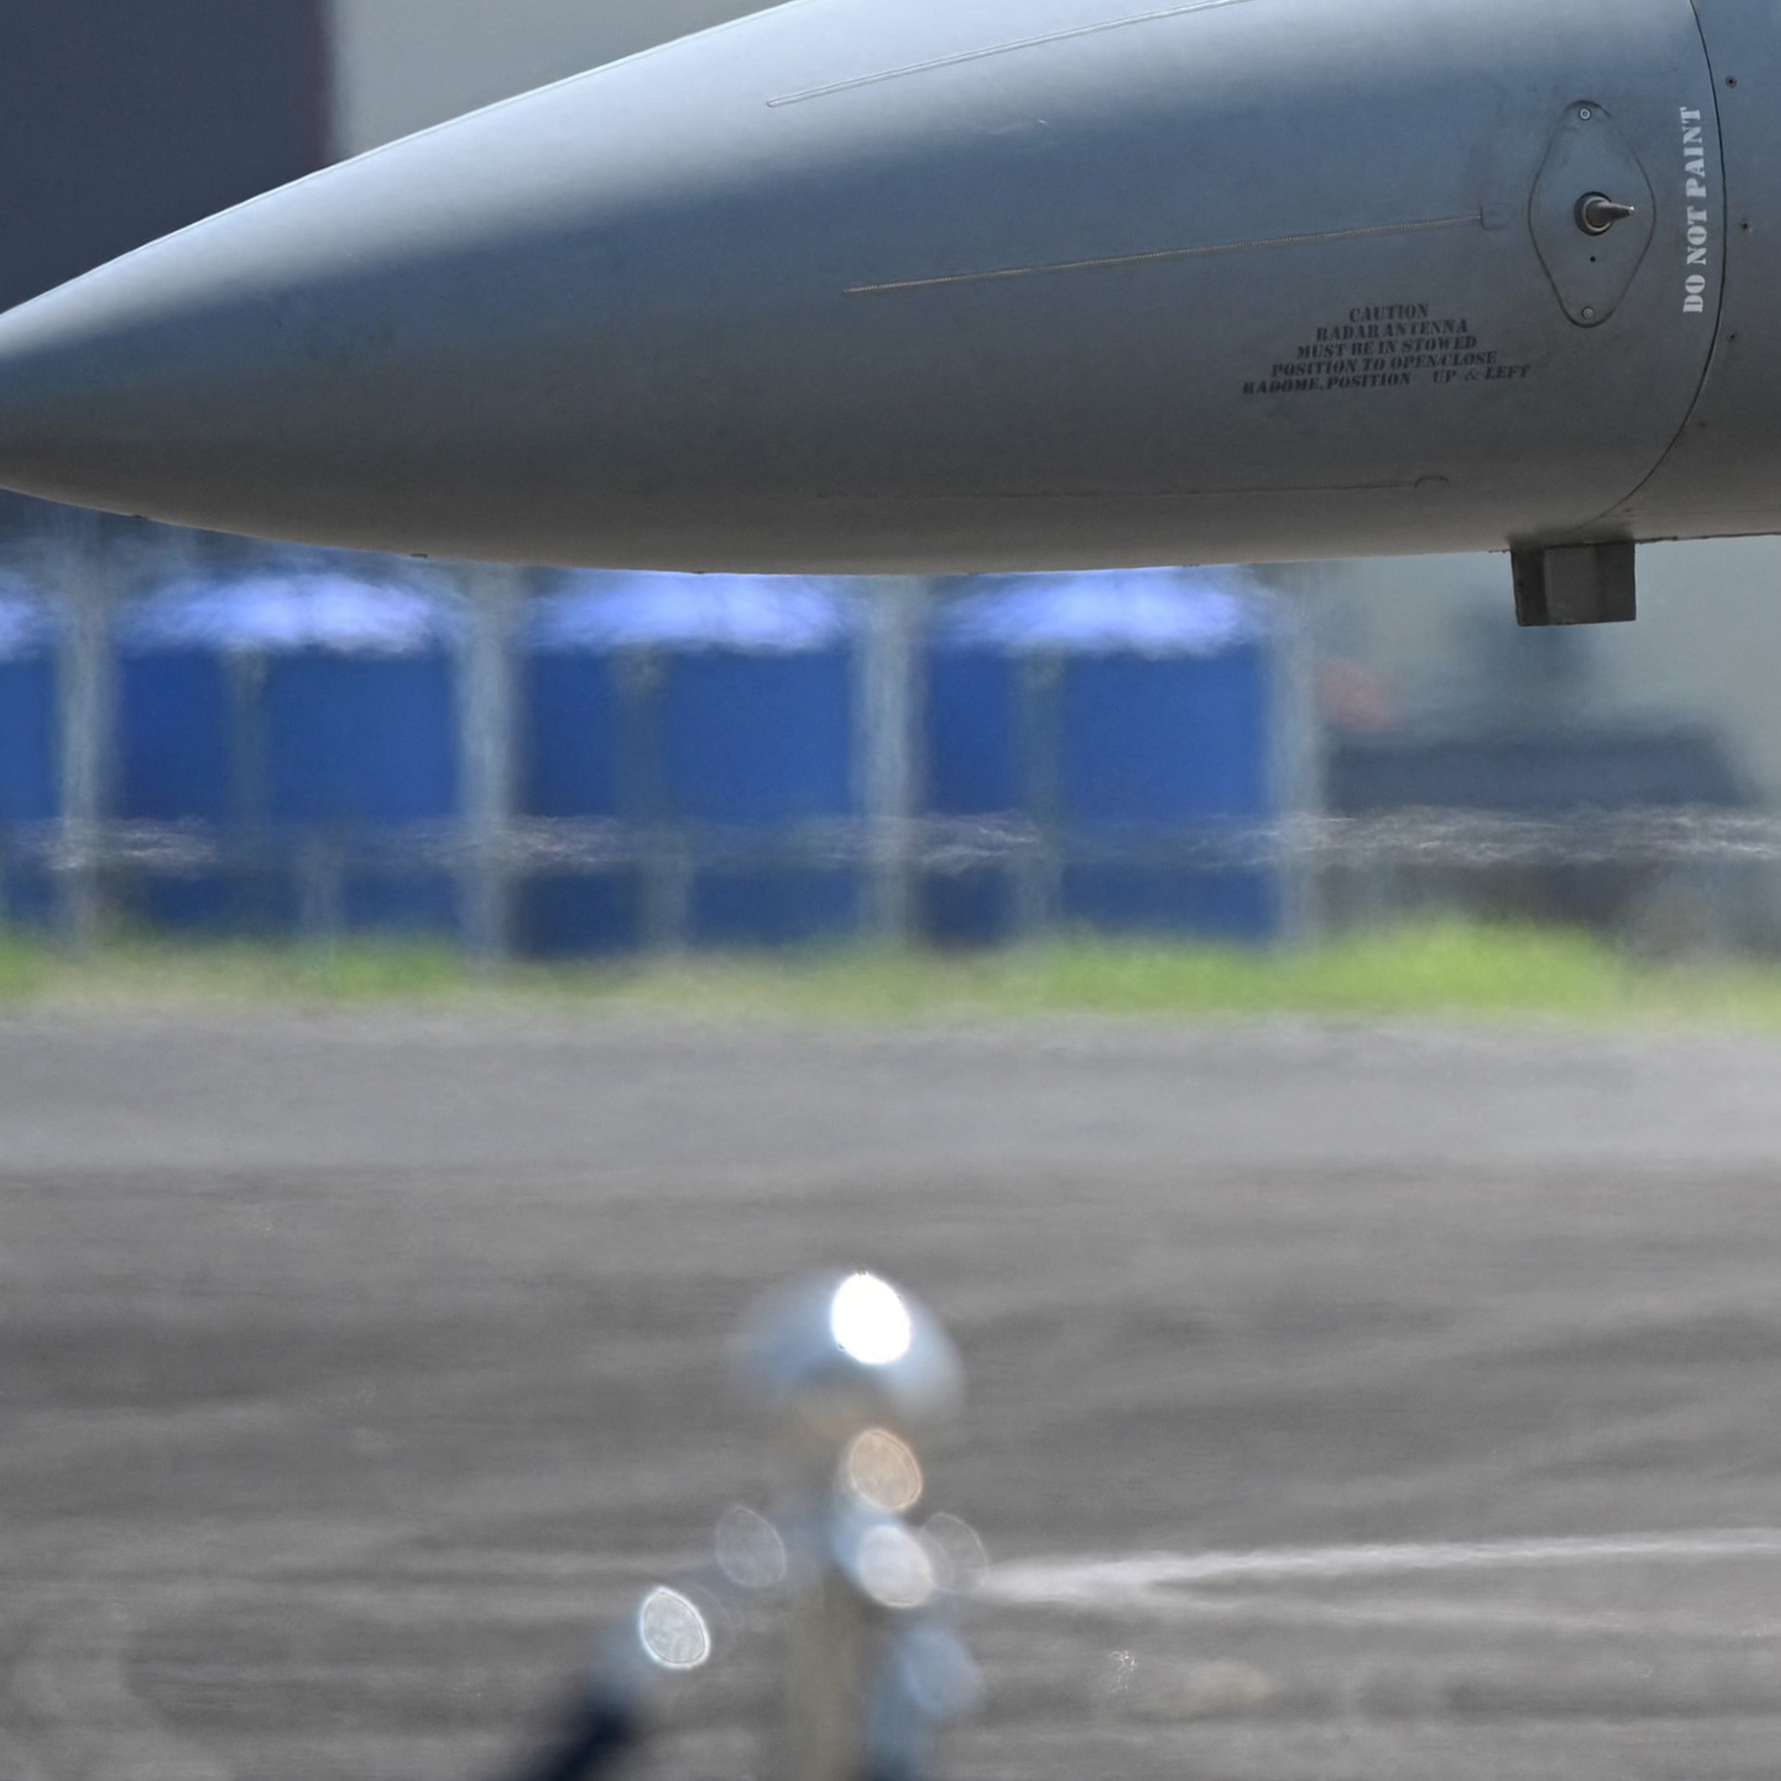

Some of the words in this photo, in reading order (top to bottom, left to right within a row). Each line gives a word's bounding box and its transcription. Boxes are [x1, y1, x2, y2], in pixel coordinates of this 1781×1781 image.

[1680, 106, 1707, 198] PAINT
[1686, 205, 1708, 265] NOT
[1682, 274, 1706, 313] DO
[1348, 303, 1430, 323] CAUTION
[1316, 325, 1380, 342] RADAR
[1382, 319, 1468, 338] ANTENNA
[1297, 342, 1346, 359] MUST
[1351, 341, 1376, 356] BE
[1378, 339, 1396, 354] IN
[1401, 334, 1478, 352] STOWED
[1271, 359, 1358, 378] POSITION
[1362, 356, 1386, 372] TO
[1390, 350, 1498, 370] OPEN/CLOSE
[1326, 372, 1412, 389] POSITION
[1432, 369, 1457, 384] UP
[1484, 364, 1531, 380] LEFT
